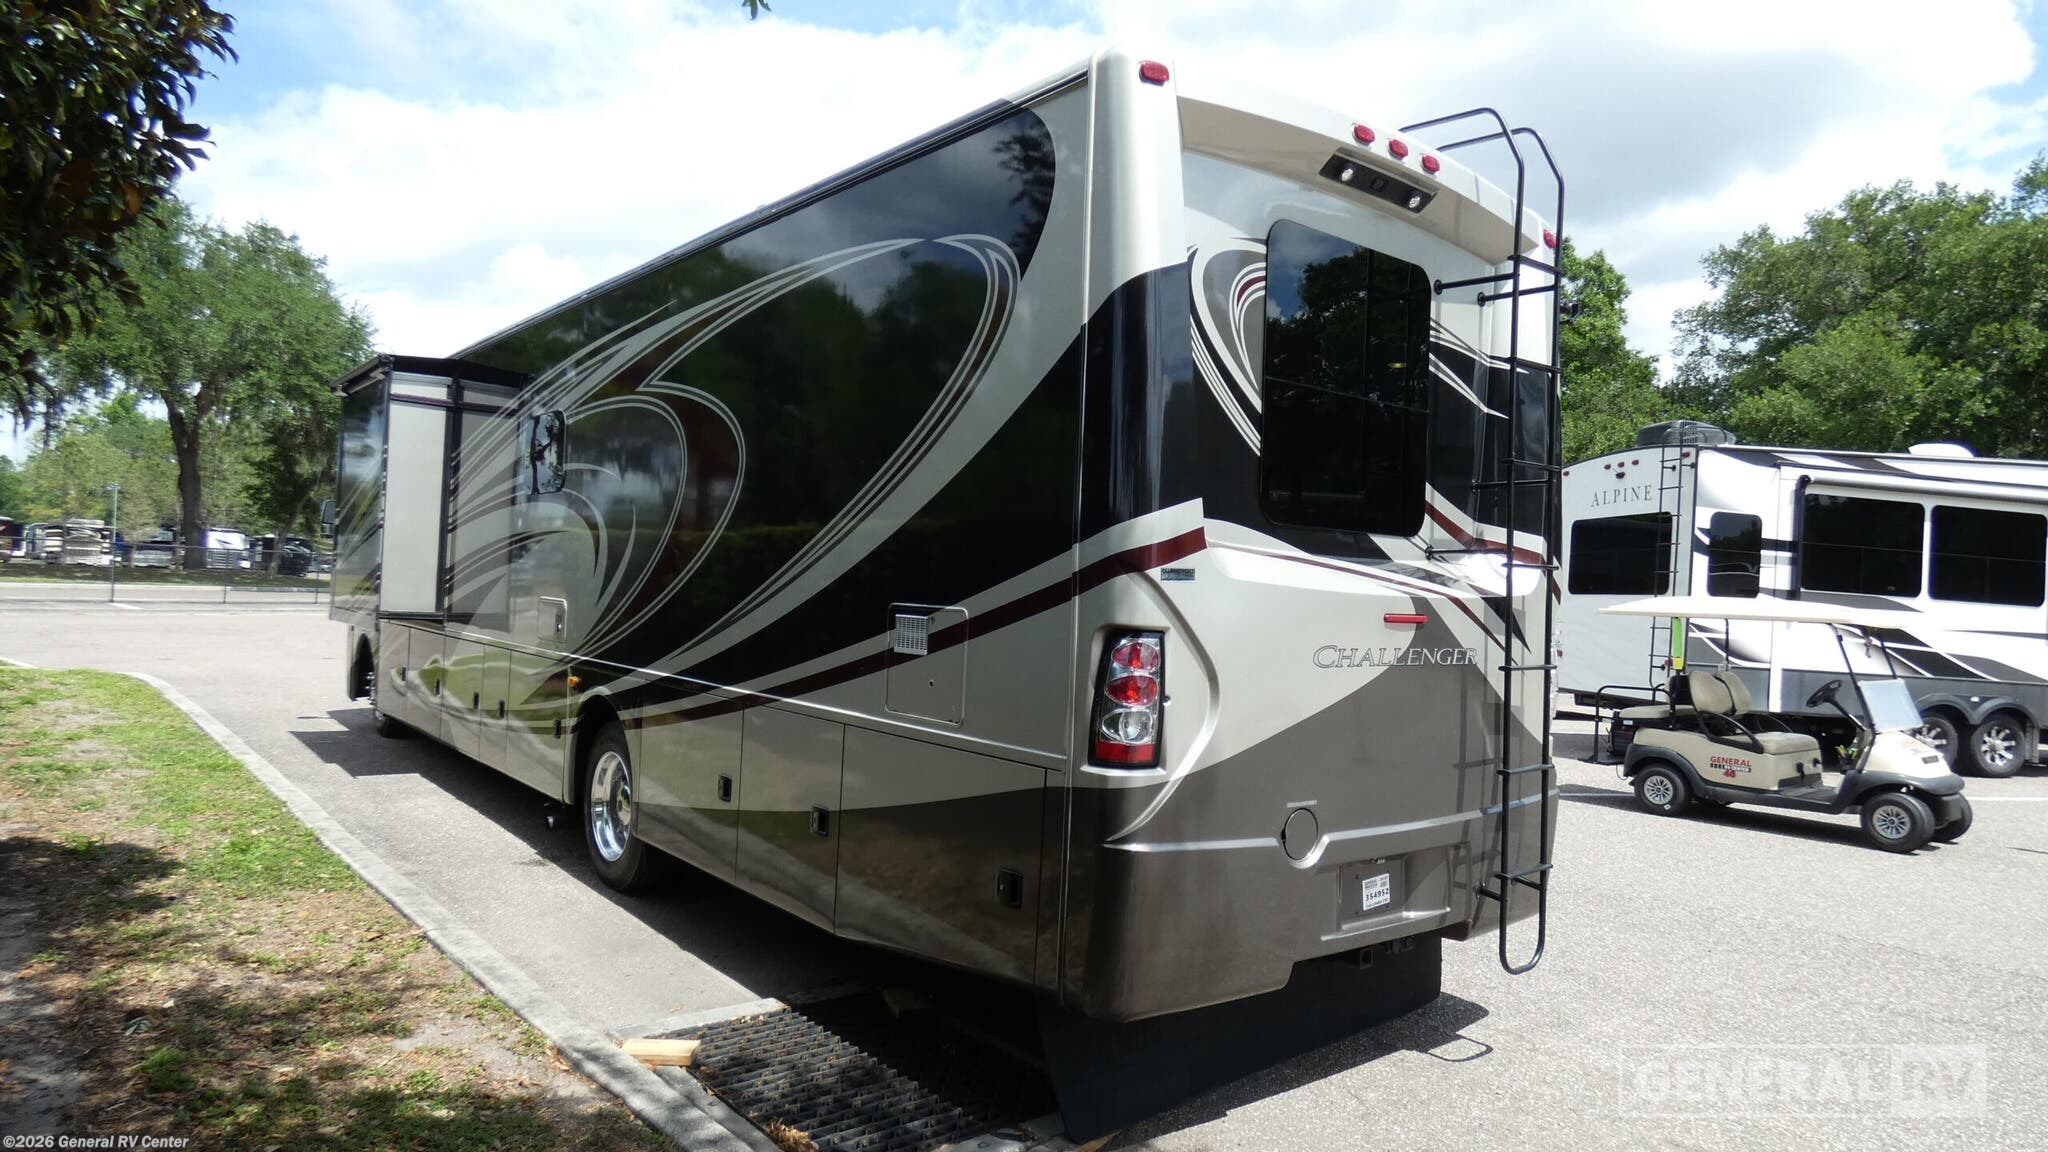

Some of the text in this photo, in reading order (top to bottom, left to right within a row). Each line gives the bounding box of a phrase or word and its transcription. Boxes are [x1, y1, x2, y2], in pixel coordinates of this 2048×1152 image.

[1591, 485, 1652, 507] ALPINE
[1313, 645, 1479, 668] CHALLENGER
[1710, 756, 1752, 767] GENERAL
